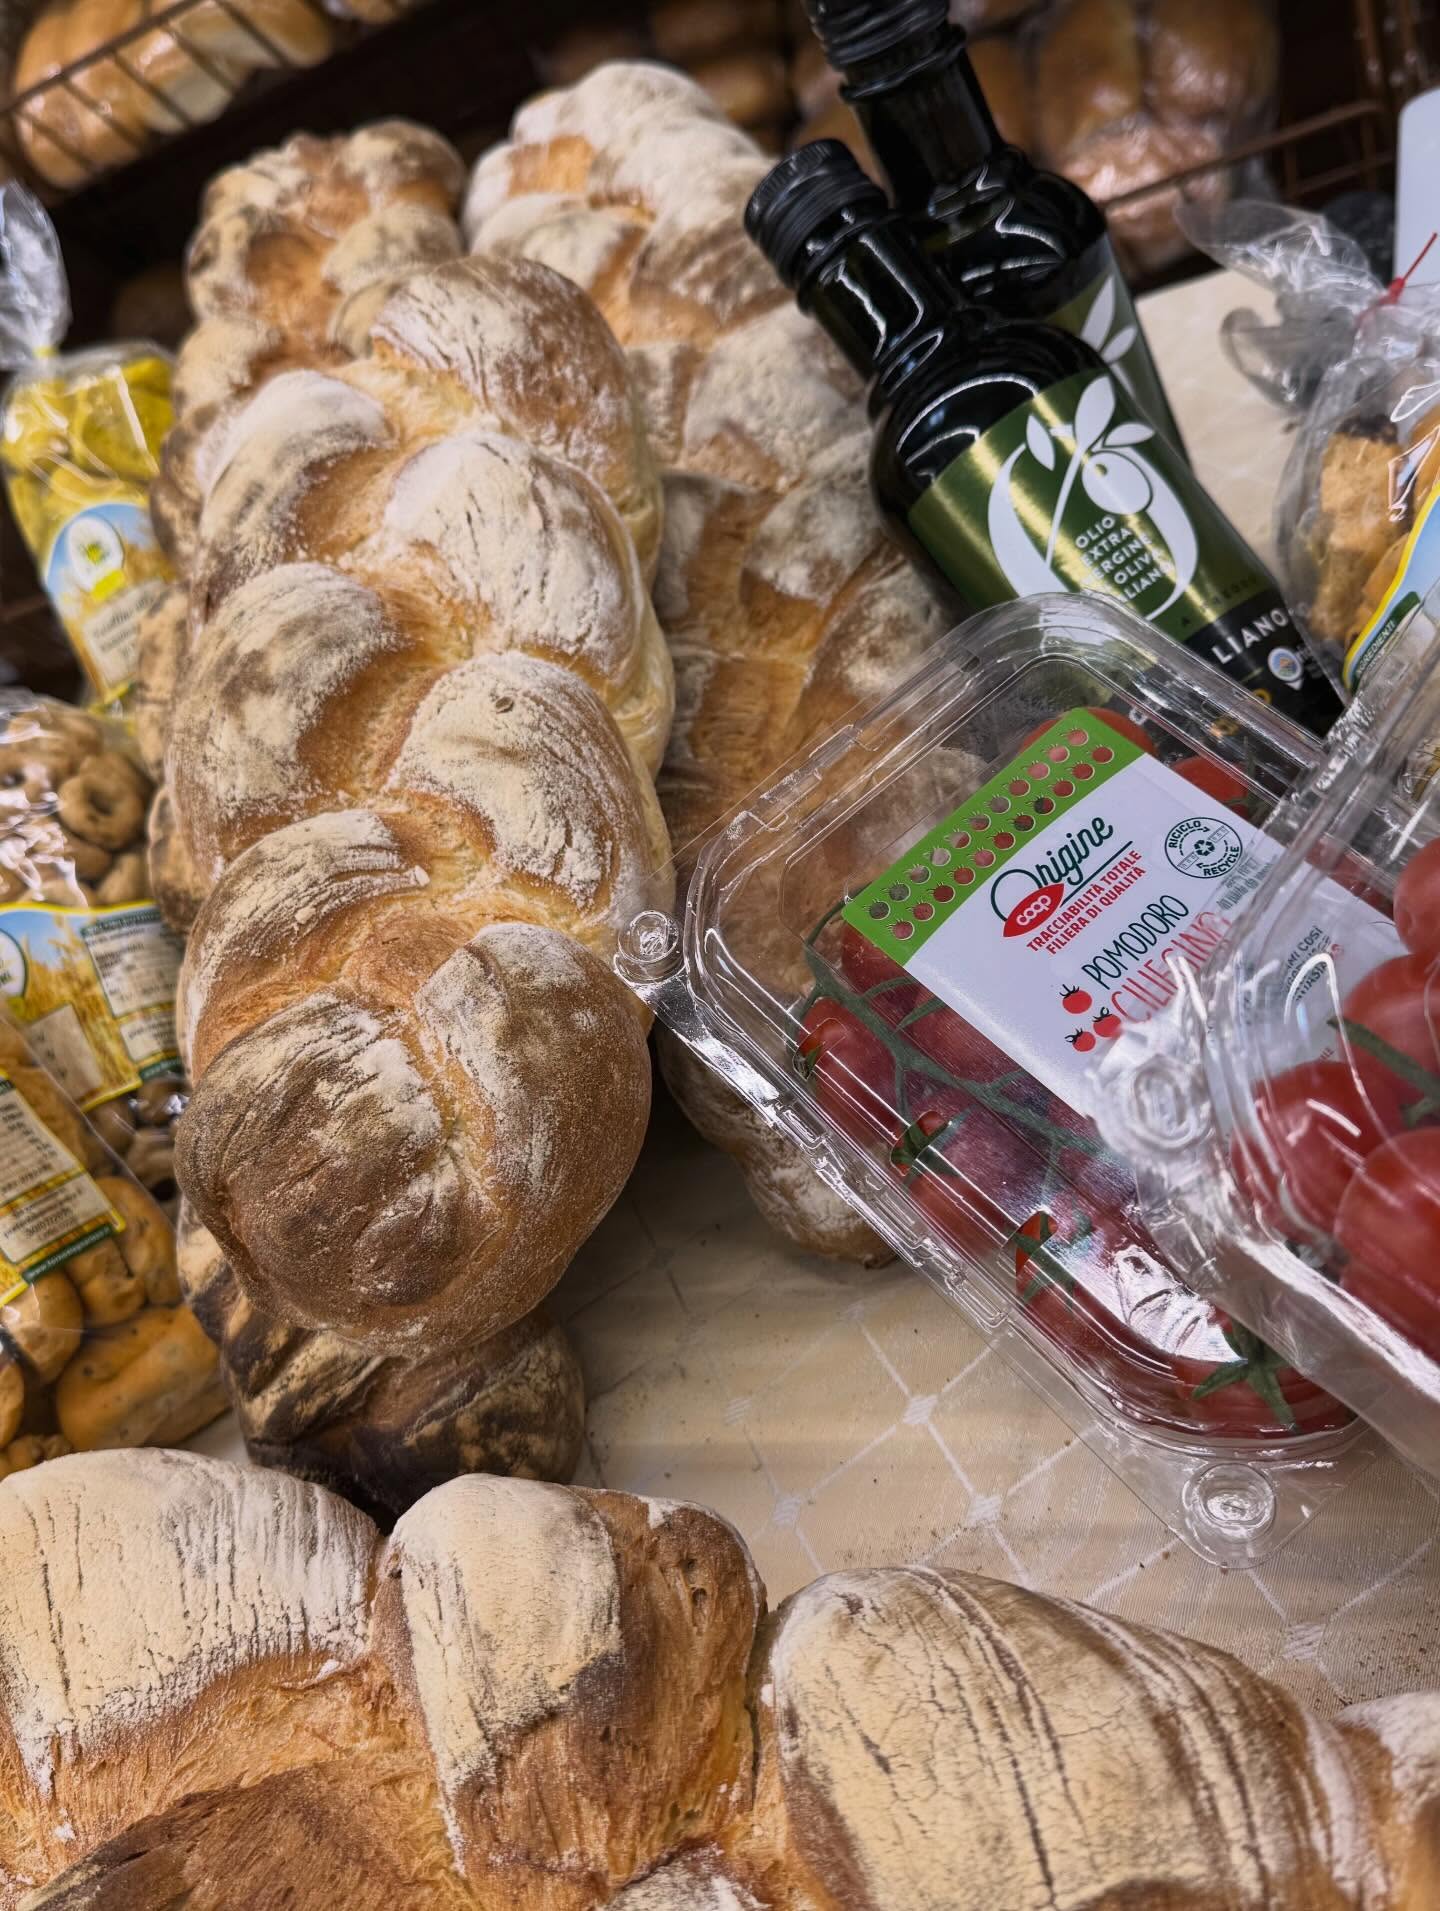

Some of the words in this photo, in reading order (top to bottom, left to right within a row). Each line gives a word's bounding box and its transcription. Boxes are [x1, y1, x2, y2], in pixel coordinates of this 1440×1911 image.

[1075, 516, 1115, 549] OLIO
[1081, 527, 1132, 568] EXTRA
[1082, 532, 1152, 584] ERGINE
[1211, 609, 1288, 665] LIANO
[1168, 820, 1202, 848] RICICLO
[1203, 846, 1240, 876] RECYCLE
[990, 816, 1114, 922] Origine
[1026, 883, 1105, 952] TRACCIABILITÀ
[1101, 850, 1142, 886] TOTALE
[1045, 916, 1090, 955] FILIERA
[1085, 905, 1102, 920] DI
[1099, 866, 1146, 907] QUALITÀ
[1081, 895, 1189, 990] POMODORO
